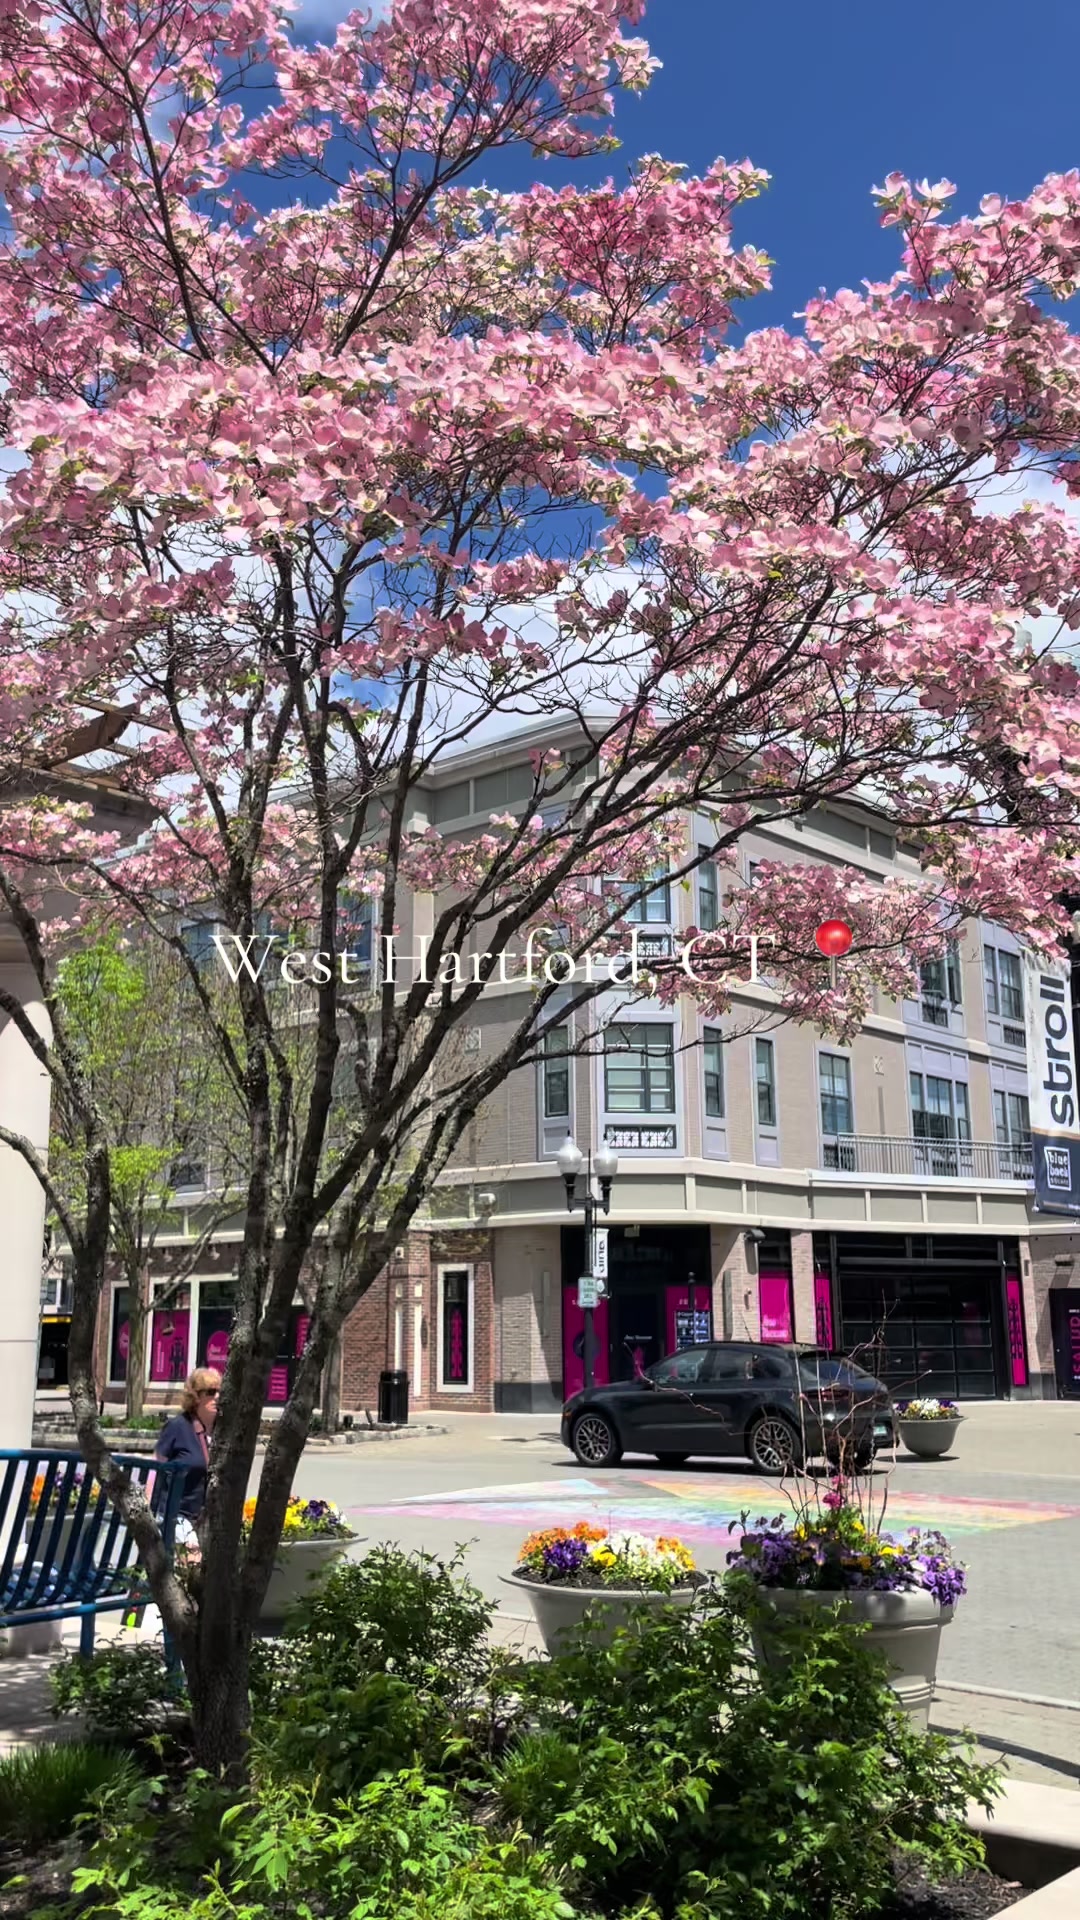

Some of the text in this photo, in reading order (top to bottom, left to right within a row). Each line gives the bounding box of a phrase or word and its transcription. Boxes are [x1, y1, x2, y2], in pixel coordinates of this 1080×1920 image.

[1039, 974, 1075, 1127] stroll
[1048, 1151, 1068, 1166] blue
[1049, 1164, 1069, 1178] back
